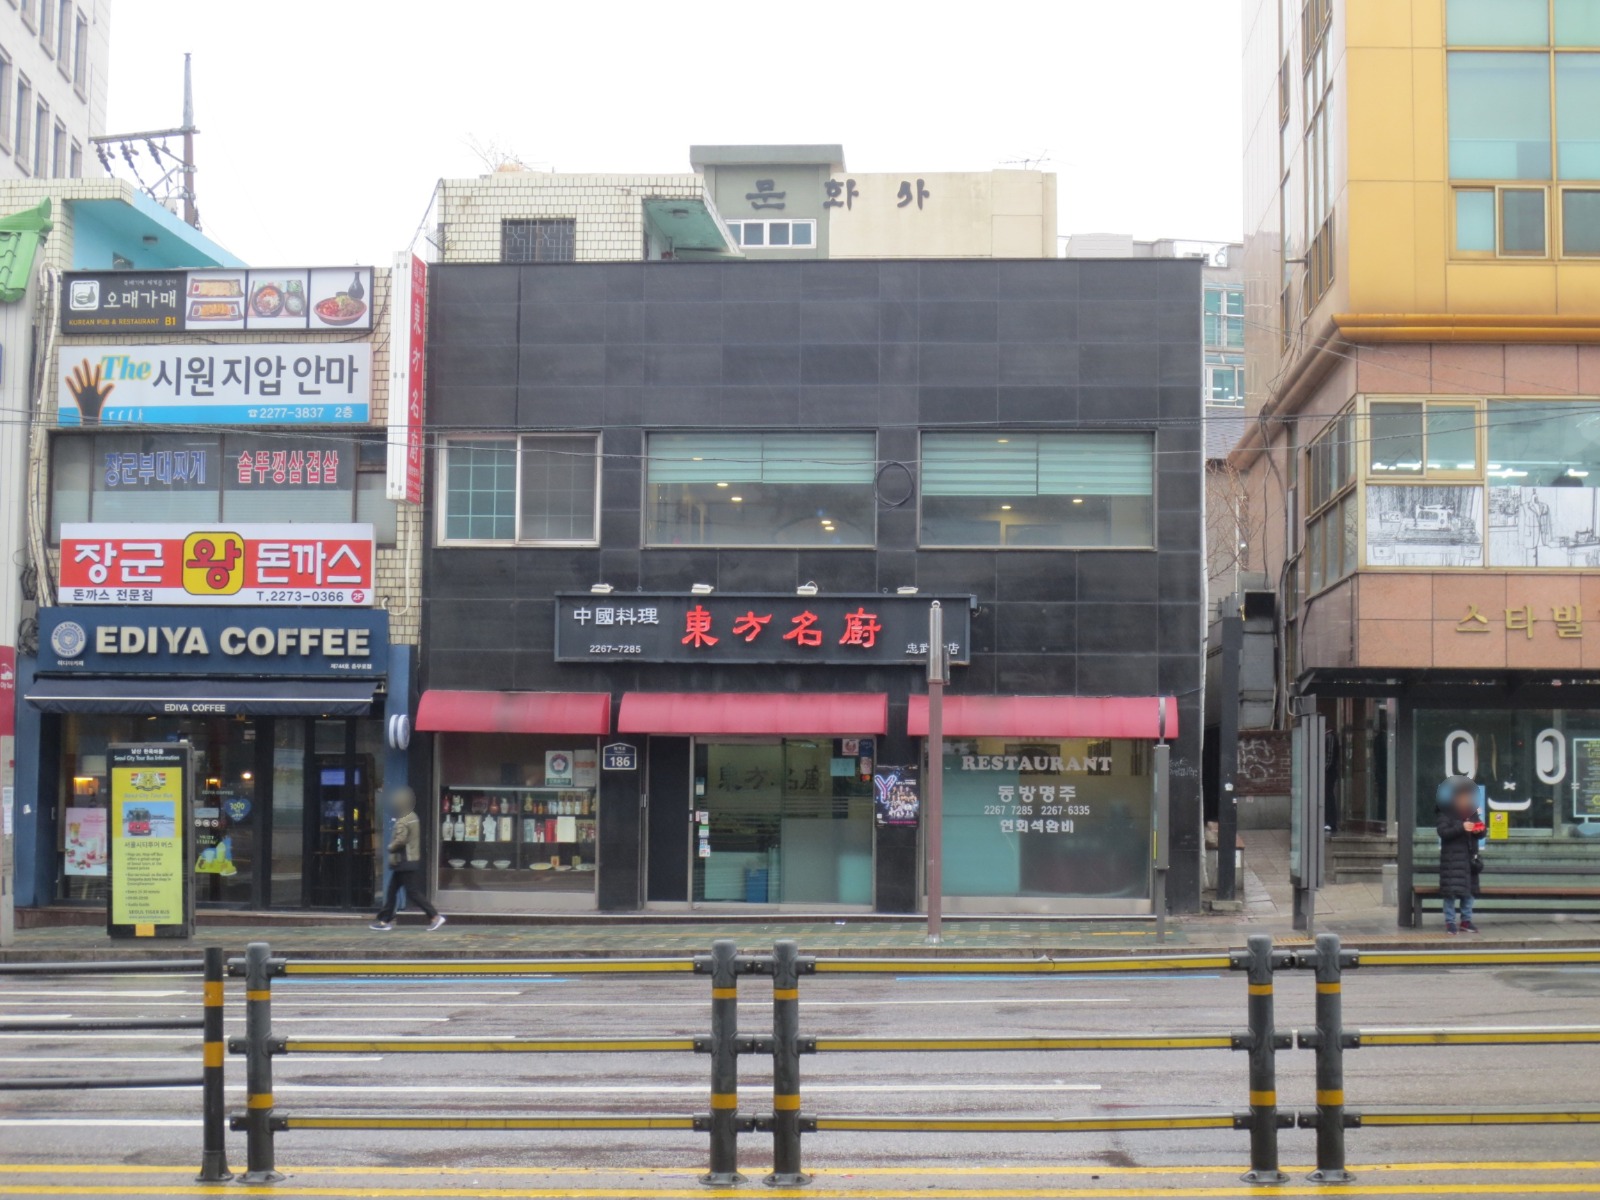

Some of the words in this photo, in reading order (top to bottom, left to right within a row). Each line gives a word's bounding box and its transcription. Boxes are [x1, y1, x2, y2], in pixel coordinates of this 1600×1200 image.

[104, 290, 176, 308] 오매가매
[164, 316, 176, 326] B1
[100, 354, 151, 380] The
[152, 356, 214, 396] 시원
[222, 355, 286, 396] 지압
[293, 354, 358, 394] 안마
[260, 408, 324, 418] 2277-3837
[335, 407, 353, 418] 2층
[104, 450, 206, 486] 장군부대찌게
[238, 450, 338, 484] 솥뚜껑삼겹살
[74, 542, 164, 584] 장군
[186, 539, 242, 590] 왕
[256, 542, 362, 585] 돈까스
[73, 588, 110, 601] 돈까스
[116, 588, 154, 601] 전문점
[256, 590, 344, 602] T.2273-0366
[574, 606, 660, 626] 中國料理
[682, 604, 882, 648] 東方名廚
[96, 626, 208, 655] EDIYA
[220, 626, 370, 656] COFFEE
[906, 642, 960, 654] 忠武店
[590, 645, 641, 653] 2267-7285
[164, 704, 190, 712] EDIYA
[192, 704, 226, 712] COFFEE
[610, 756, 630, 767] 186
[961, 756, 1112, 771] RESTAURANT
[998, 786, 1076, 802] 동방명주
[1041, 806, 1090, 815] 2267-6335
[1000, 819, 1074, 833] 연회석완비
